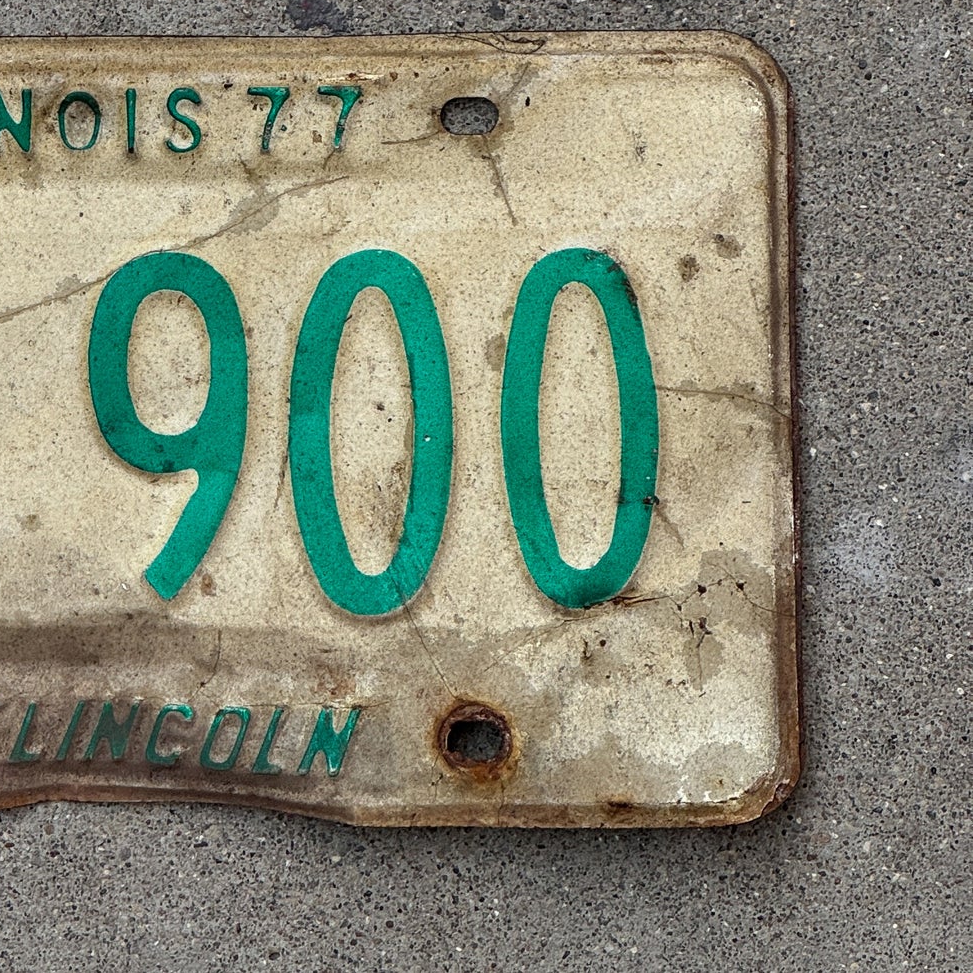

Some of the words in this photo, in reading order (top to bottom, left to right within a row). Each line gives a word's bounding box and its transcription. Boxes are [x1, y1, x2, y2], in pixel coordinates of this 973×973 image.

[246, 85, 362, 152] 77
[87, 246, 660, 616] 900
[9, 701, 364, 778] LINCOLN
